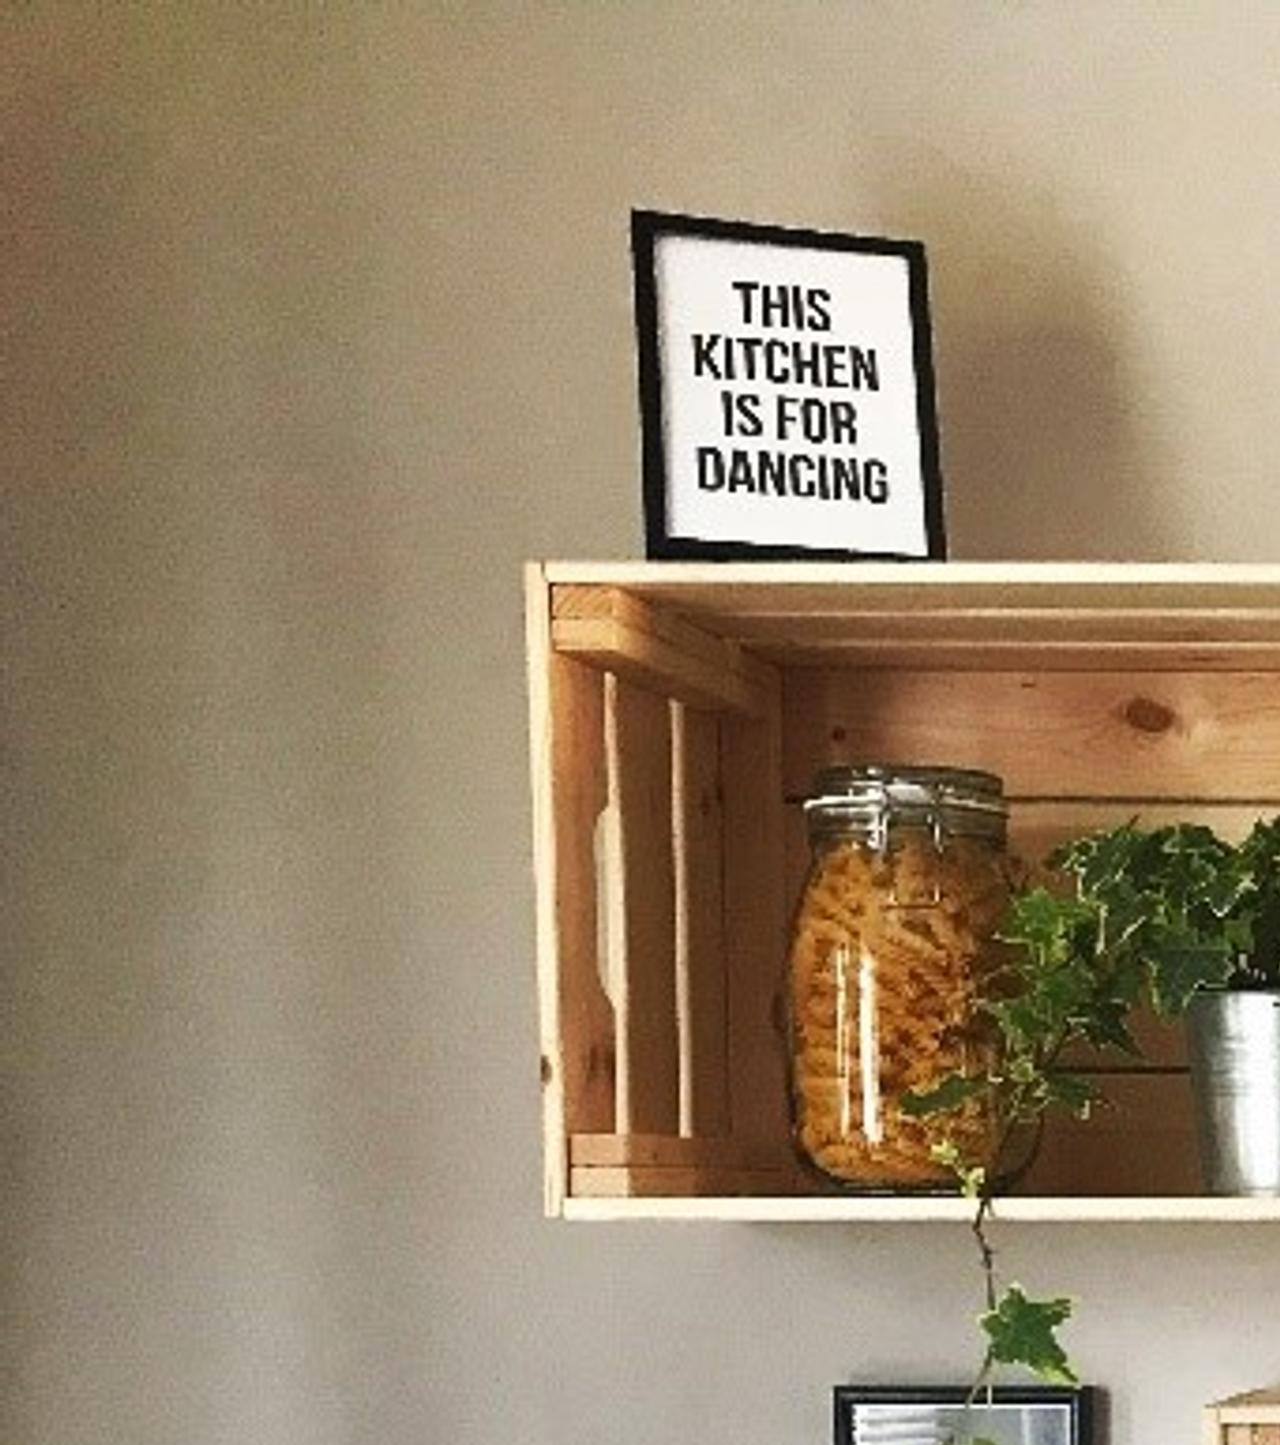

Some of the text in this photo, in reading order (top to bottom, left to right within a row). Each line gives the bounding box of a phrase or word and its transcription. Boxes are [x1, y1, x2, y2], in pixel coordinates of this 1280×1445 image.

[732, 281, 831, 331] THIS
[691, 334, 879, 391] KITCHEN
[721, 390, 857, 444] IS FOR
[696, 447, 889, 504] DANCING
